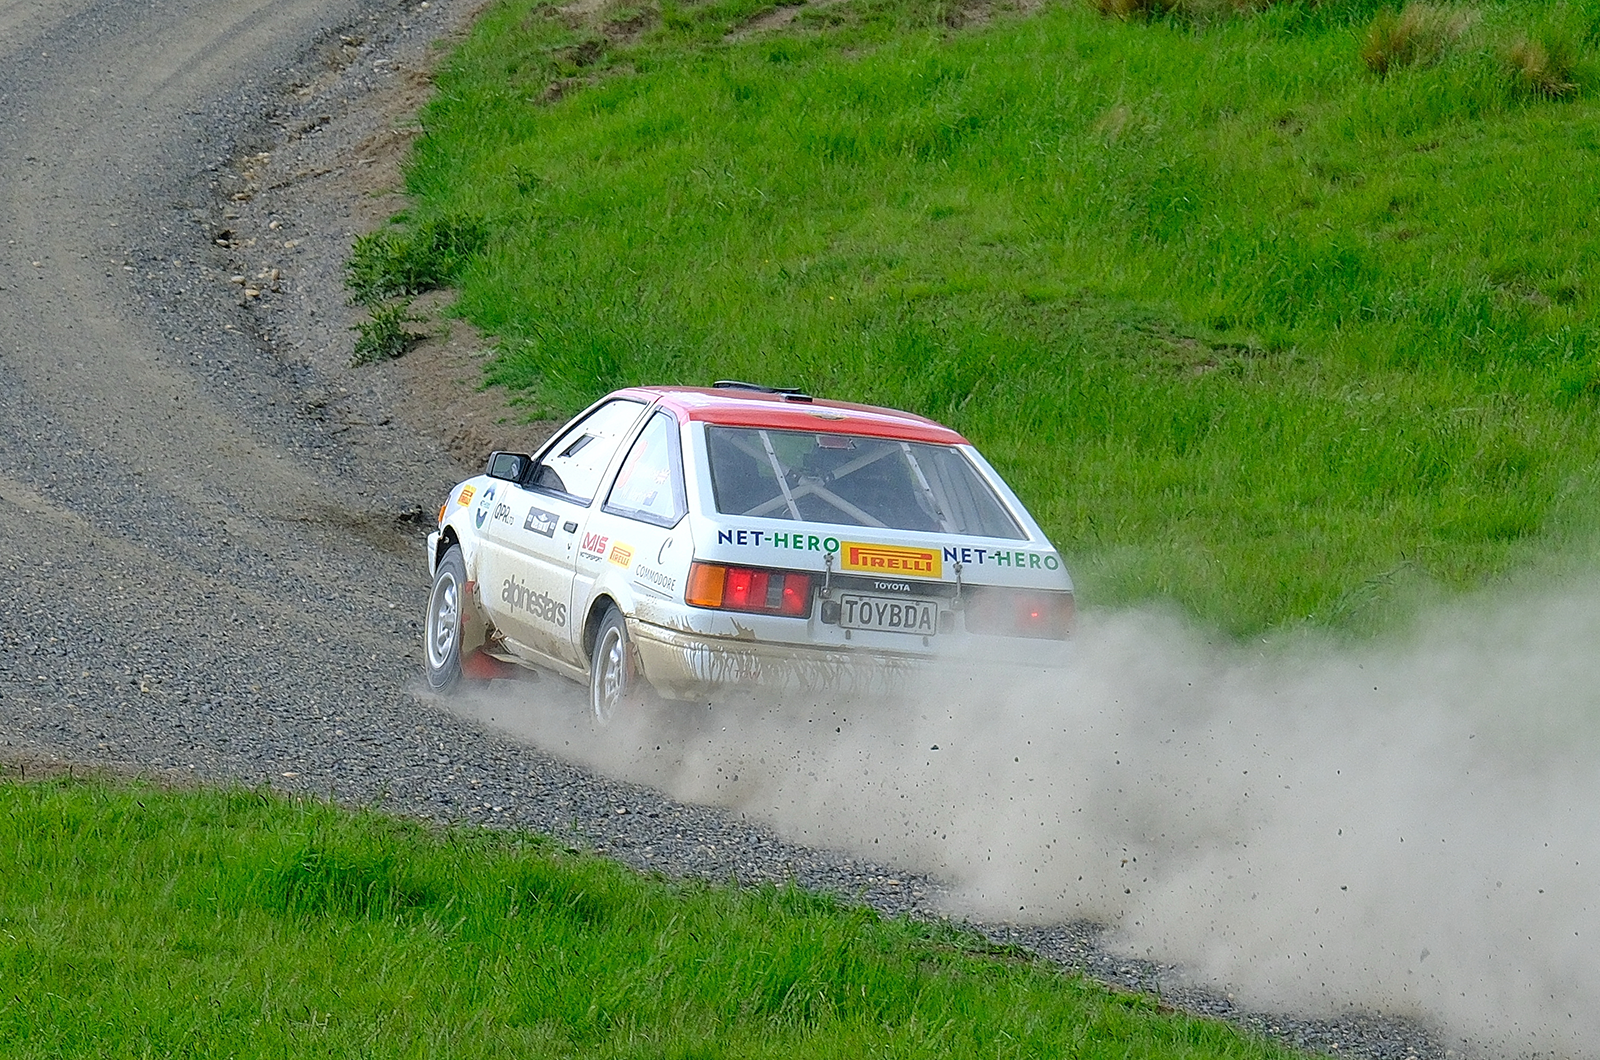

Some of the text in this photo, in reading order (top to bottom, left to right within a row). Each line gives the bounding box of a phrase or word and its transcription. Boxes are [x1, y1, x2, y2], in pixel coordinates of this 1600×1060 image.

[718, 529, 840, 553] NET-HERO
[849, 546, 933, 572] PIRELLI
[942, 546, 1060, 571] NET-HERO
[635, 564, 676, 592] COMMODORE
[874, 581, 911, 592] TOYOTA
[502, 574, 566, 627] alpinestars
[845, 599, 932, 631] TOYBDA
